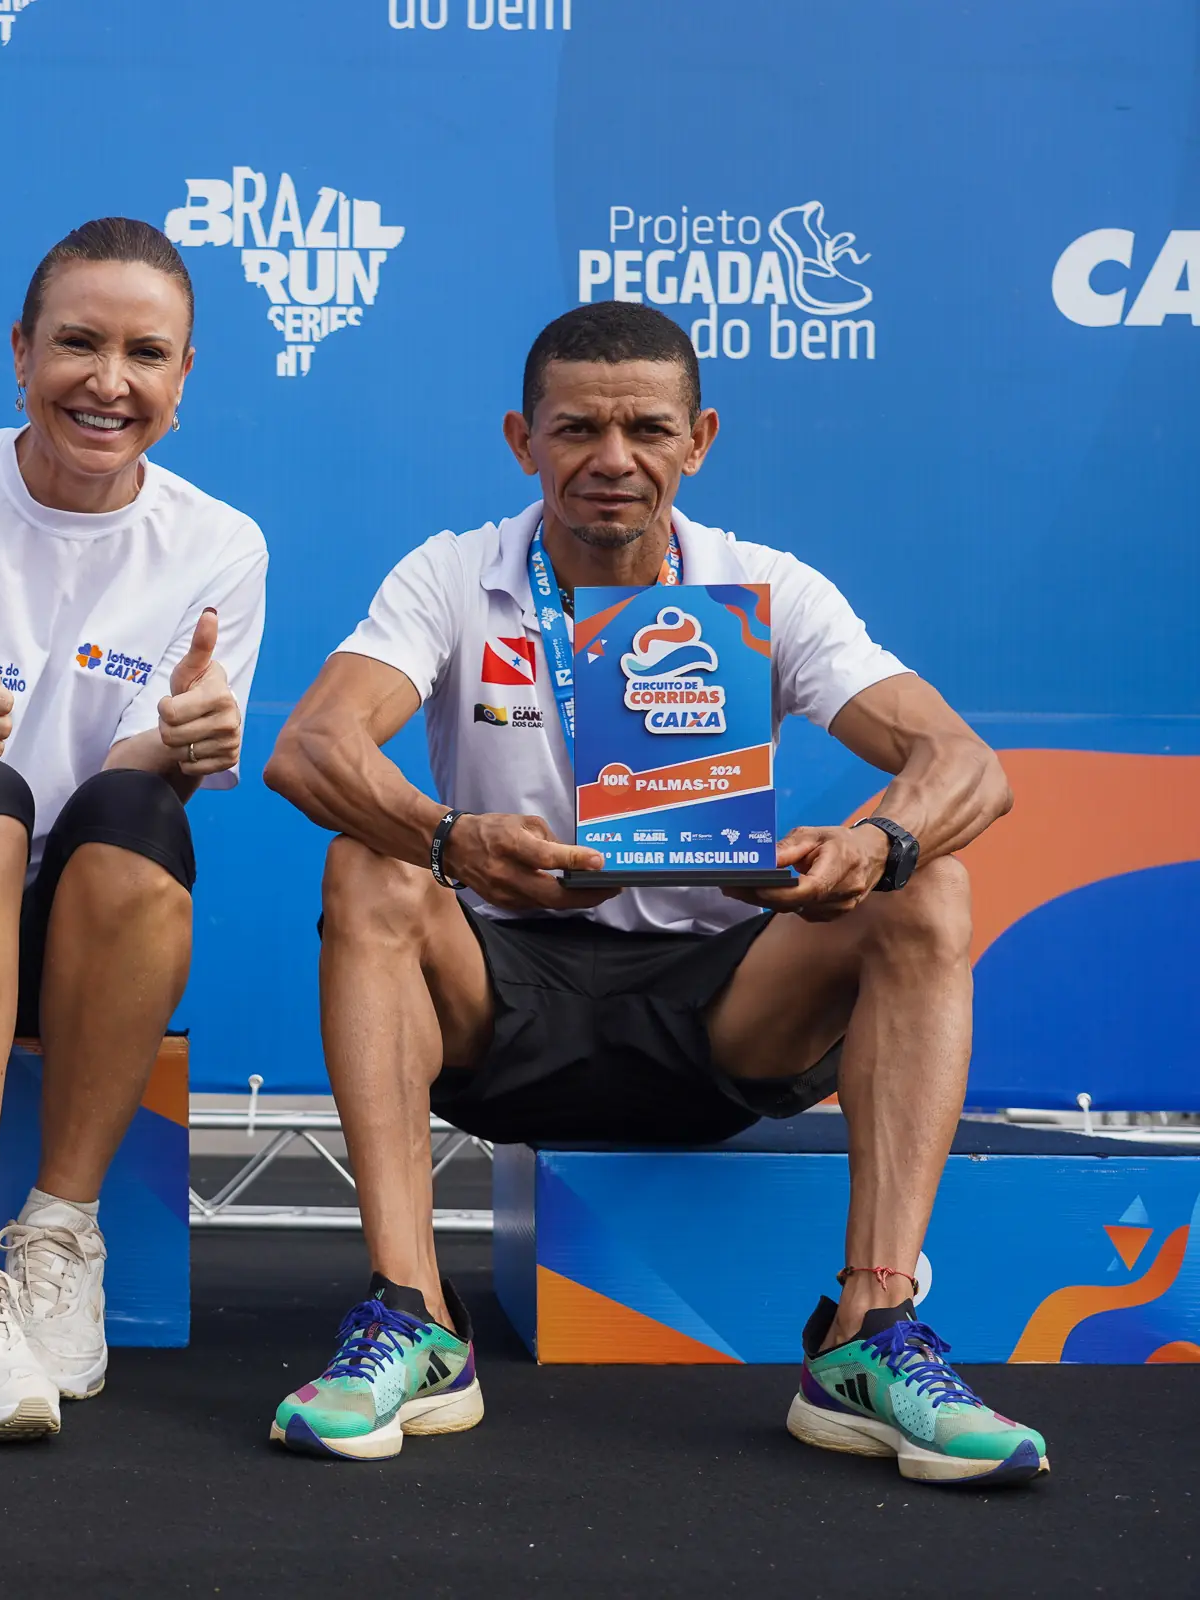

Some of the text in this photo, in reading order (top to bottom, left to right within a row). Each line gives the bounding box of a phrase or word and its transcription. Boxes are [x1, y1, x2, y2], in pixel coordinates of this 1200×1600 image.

[164, 166, 406, 249] BRAZIL
[609, 205, 762, 253] Projeto
[241, 249, 388, 305] RUN
[578, 249, 789, 305] PEGADA
[691, 304, 877, 360] do bem
[532, 551, 551, 596] CAIXA
[106, 649, 153, 672] loterias
[104, 661, 148, 686] CAIXA
[629, 690, 720, 704] CORRIDAS
[632, 681, 698, 690] CIRCUITO DE
[650, 711, 721, 728] CAIXA
[709, 765, 741, 776] 2024
[602, 774, 729, 791] 10K PALMAS-TO
[585, 832, 622, 842] CAIXA
[616, 851, 664, 864] LUGAR
[669, 851, 760, 864] MASCULINO
